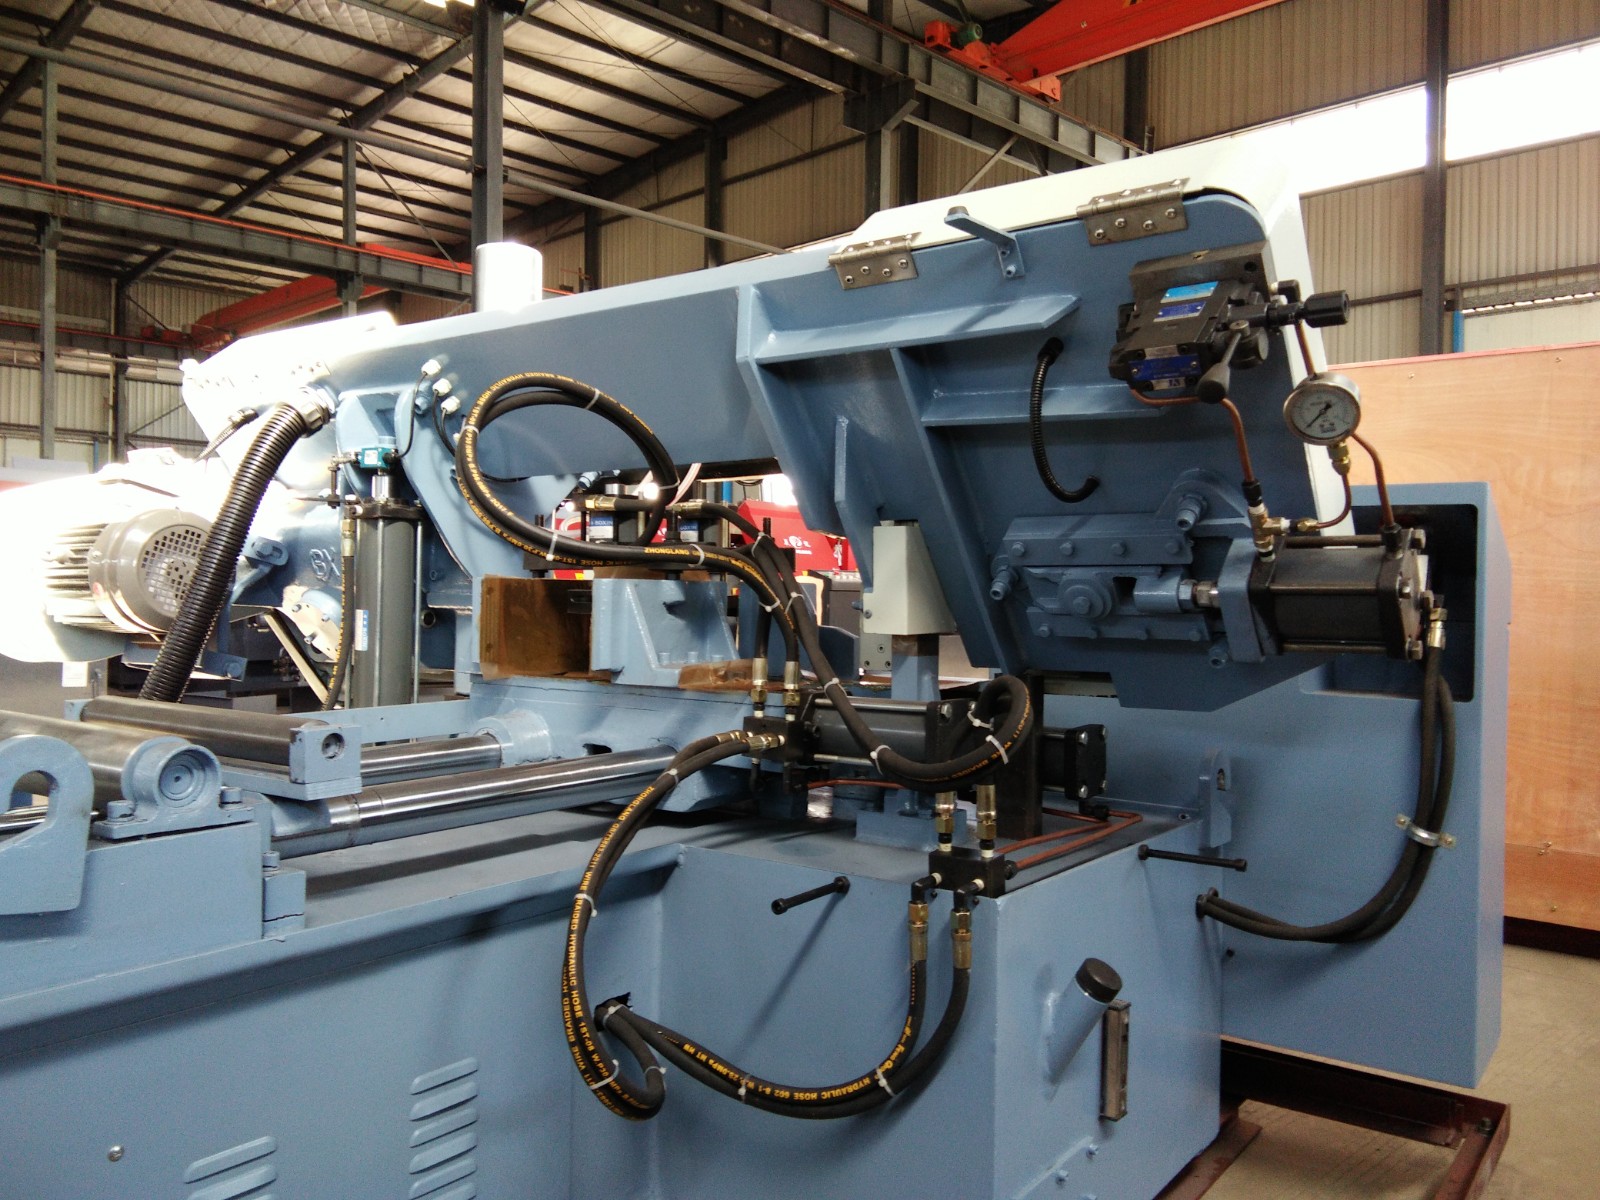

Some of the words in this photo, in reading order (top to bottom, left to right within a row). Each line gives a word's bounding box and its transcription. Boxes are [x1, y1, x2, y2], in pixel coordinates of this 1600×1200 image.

[644, 547, 690, 556] ZHONGLANG
[618, 785, 655, 821] ZHONGLANG
[580, 871, 592, 890] WIRE
[568, 933, 577, 986] HYDRAULIC
[571, 989, 582, 1018] HOSE
[563, 1000, 576, 1043] BRAIDED
[571, 1046, 586, 1069] WIRE
[793, 1091, 817, 1100] HOSE
[821, 1077, 871, 1099] HYDRAULIC
